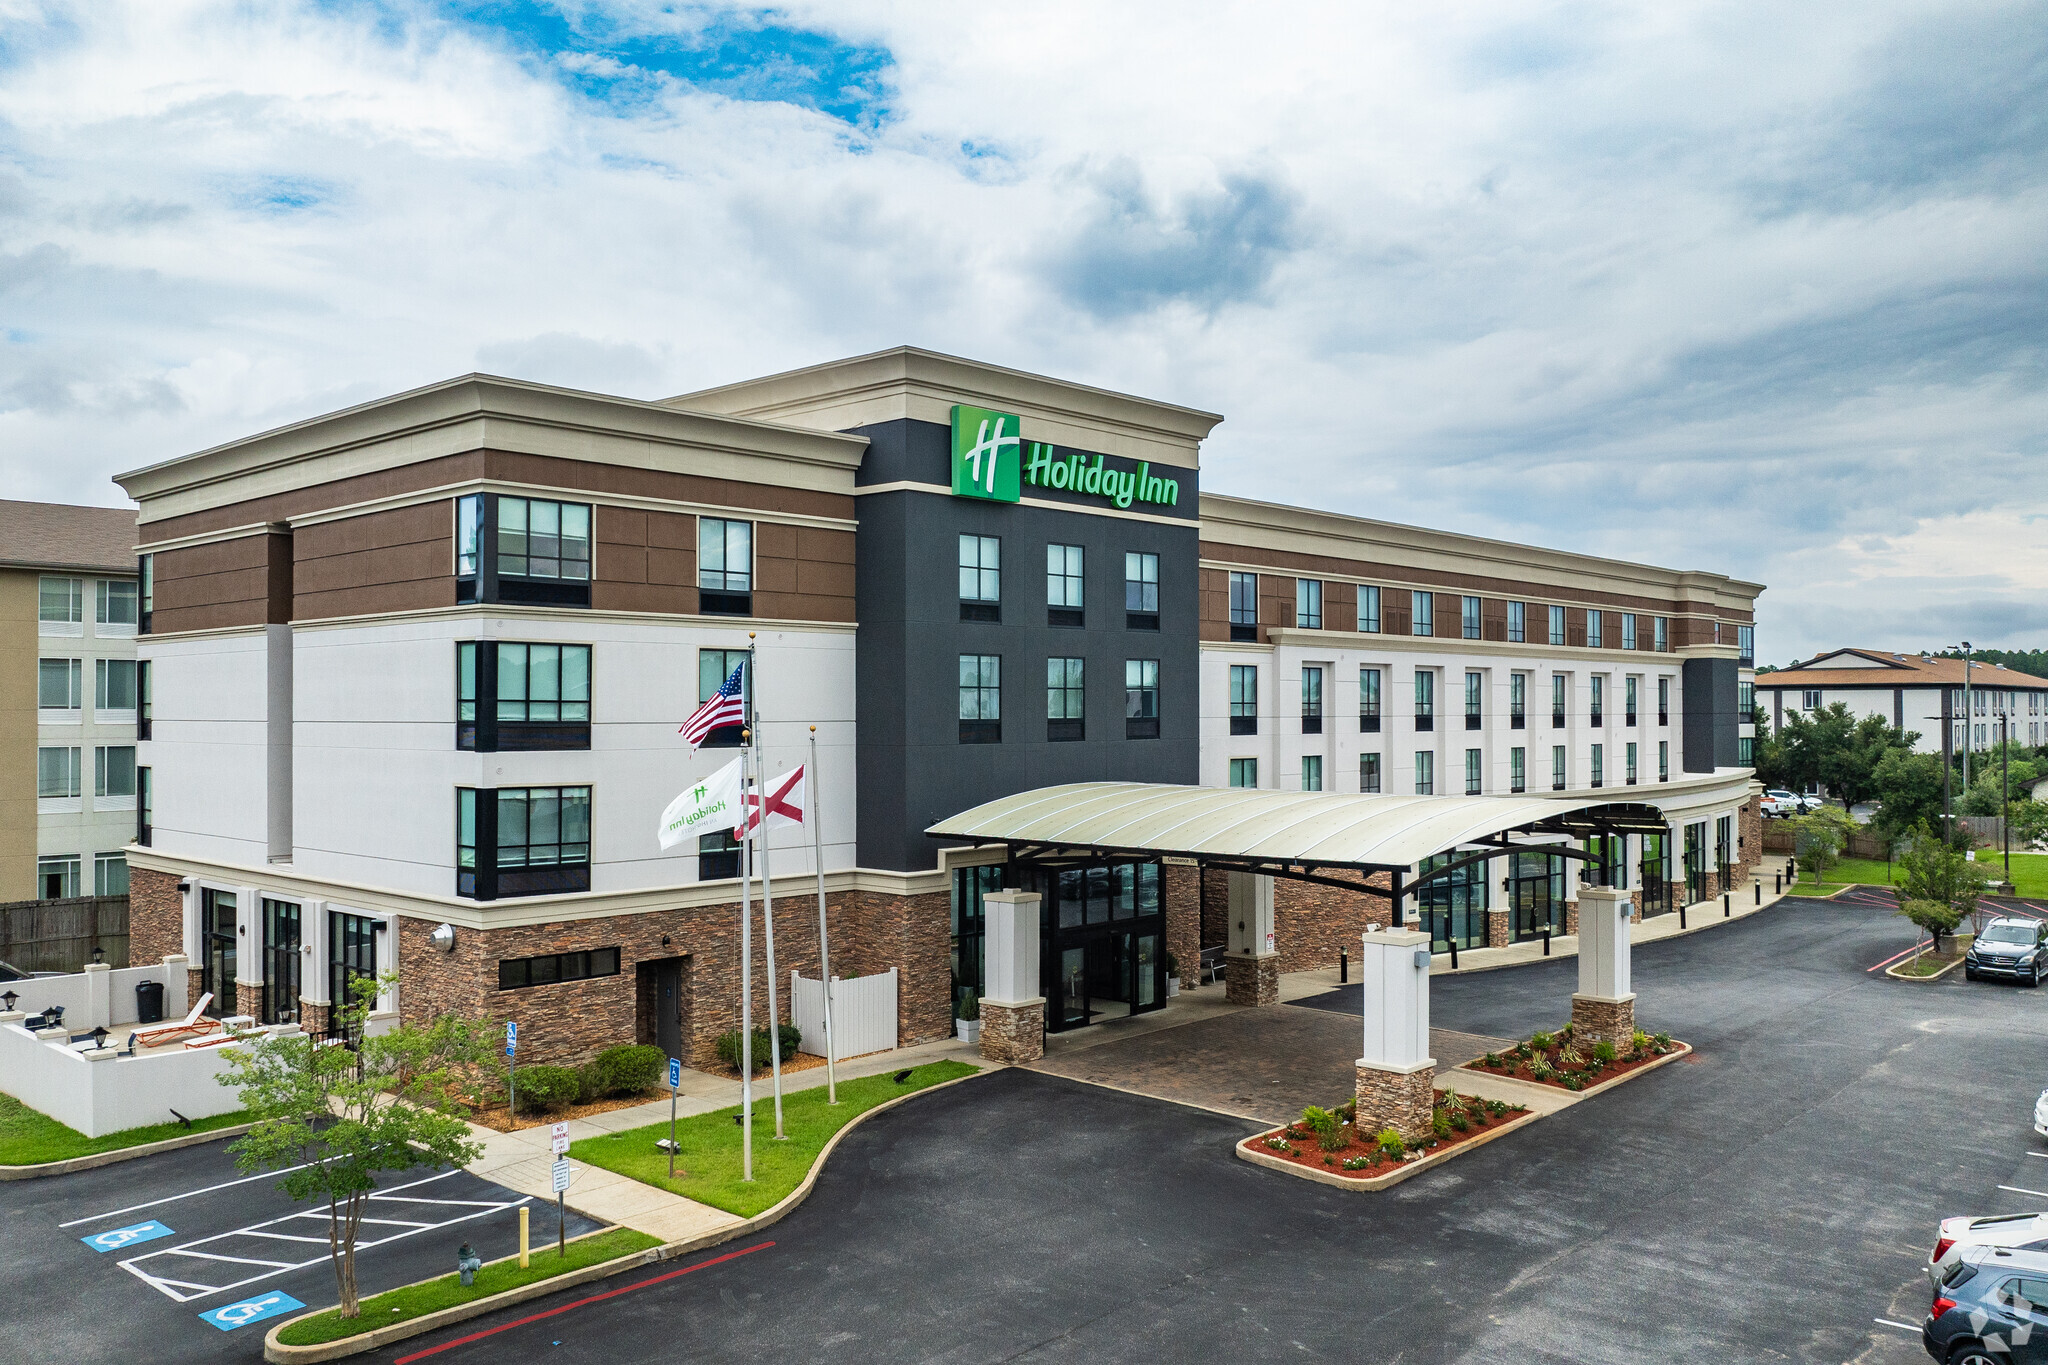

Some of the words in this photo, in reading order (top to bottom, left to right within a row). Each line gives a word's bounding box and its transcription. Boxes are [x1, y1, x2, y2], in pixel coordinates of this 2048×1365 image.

[1023, 442, 1134, 508] Holiday
[1134, 462, 1179, 506] Inn
[552, 1131, 568, 1140] PARKING
